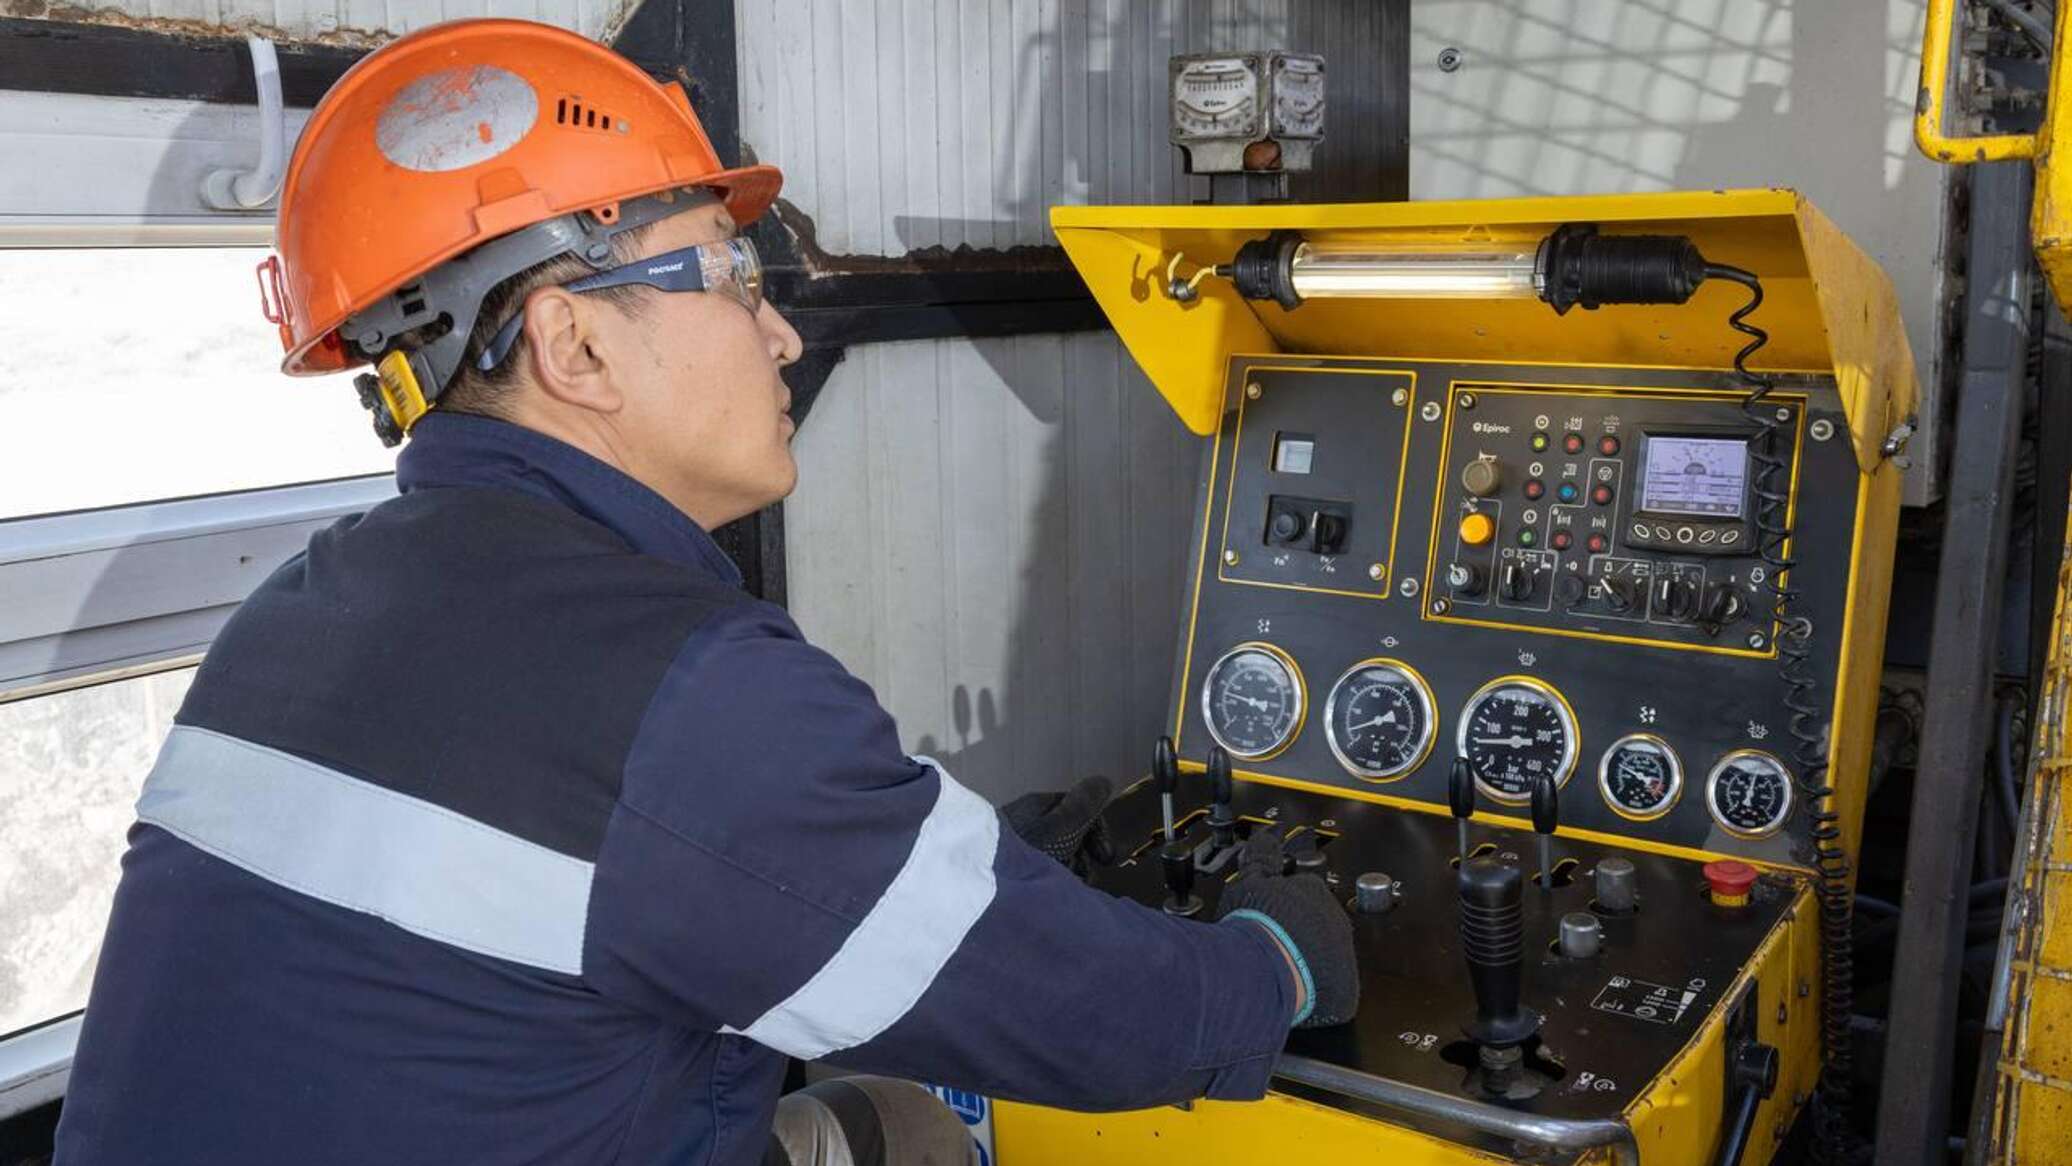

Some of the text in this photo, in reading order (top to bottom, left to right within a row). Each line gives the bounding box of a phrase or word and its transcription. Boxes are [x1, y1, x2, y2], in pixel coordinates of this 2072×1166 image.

[1482, 422, 1511, 434] Epiroc
[1513, 704, 1529, 717] 200
[1487, 722, 1501, 734] 100
[1536, 729, 1552, 742] 300
[1488, 754, 1495, 766] 0
[1526, 759, 1542, 772] 400
[1507, 763, 1520, 773] bar
